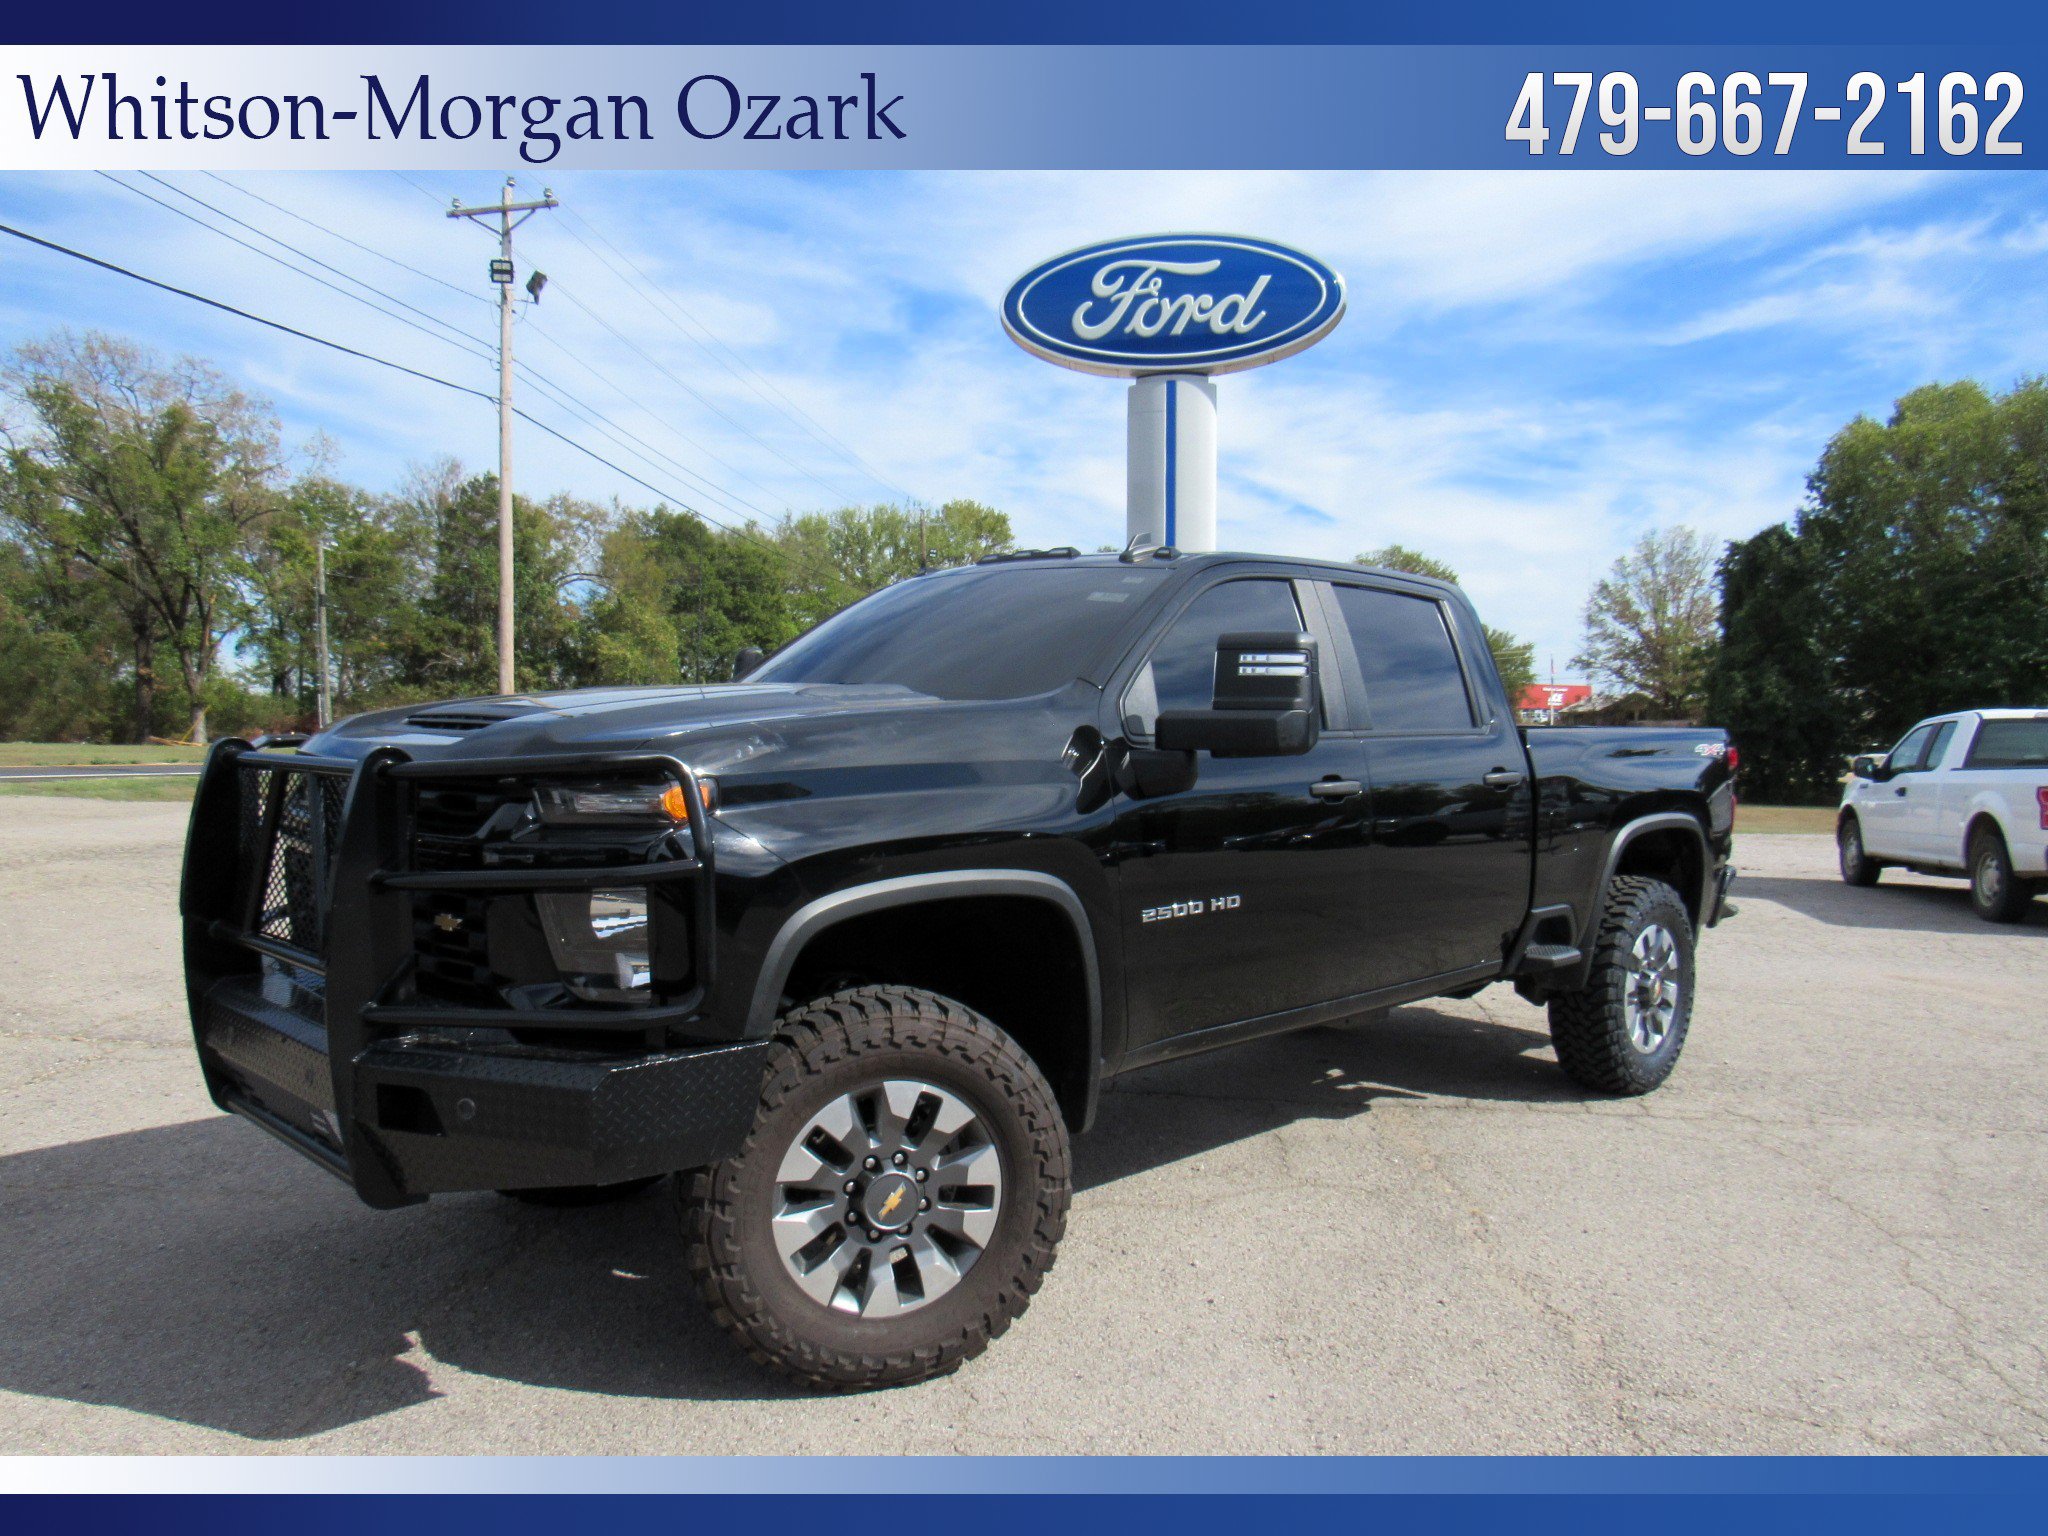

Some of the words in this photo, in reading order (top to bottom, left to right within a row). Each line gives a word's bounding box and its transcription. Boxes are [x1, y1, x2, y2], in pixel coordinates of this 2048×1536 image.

[1072, 259, 1272, 341] Ford
[1141, 900, 1204, 923] 2500
[1210, 894, 1241, 912] HD
